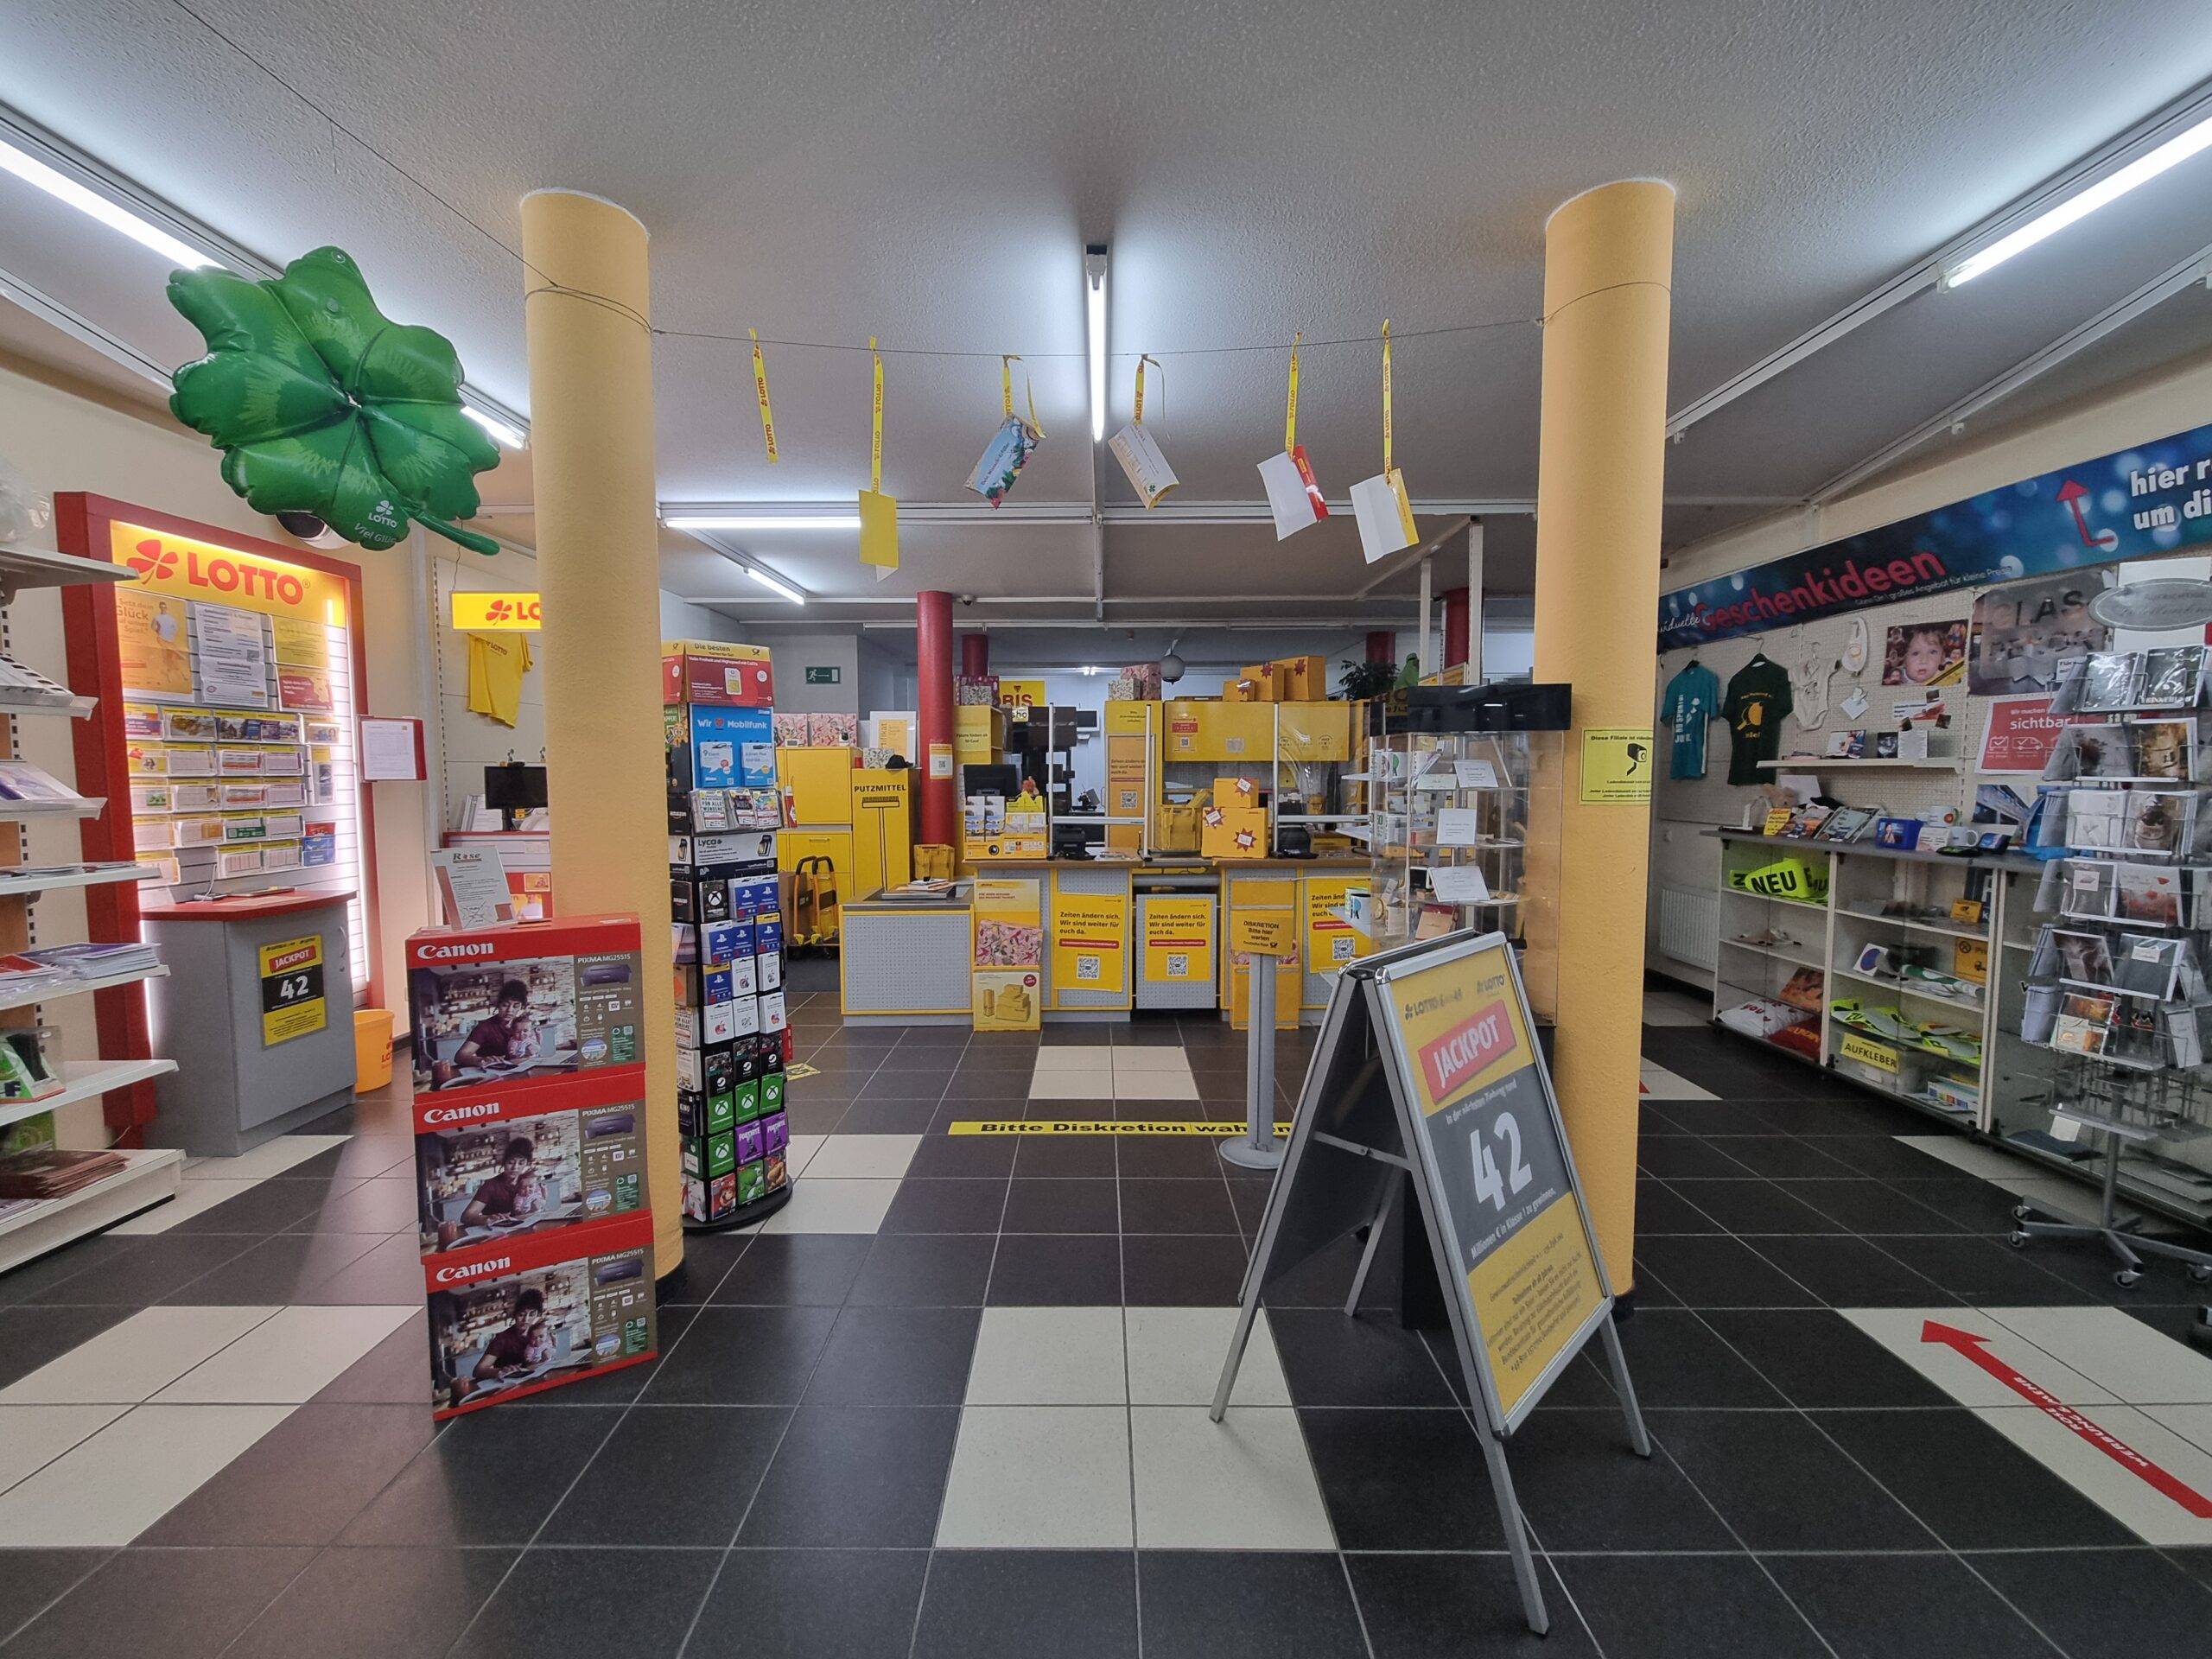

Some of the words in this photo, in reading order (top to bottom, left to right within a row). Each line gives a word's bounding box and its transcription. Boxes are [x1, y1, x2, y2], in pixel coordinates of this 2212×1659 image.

[758, 377, 766, 398] LOTTO
[765, 423, 774, 446] LOTTO
[2131, 465, 2190, 497] hier
[368, 512, 397, 528] LOTTO
[2133, 505, 2175, 530] um
[354, 523, 374, 540] Viel
[187, 551, 303, 606] LOTTO
[1915, 580, 1948, 594] Angebot
[1949, 575, 1961, 586] für
[1962, 571, 1986, 582] kleine
[1696, 550, 1947, 632] Geschenkideen
[116, 606, 149, 621] Glück
[707, 644, 731, 652] besten
[696, 719, 712, 728] Wir
[727, 720, 767, 729] Mobilfunk
[2010, 716, 2072, 730] sichtbar
[854, 784, 906, 793] PUTZMITTEL
[697, 838, 717, 849] Lyca
[1751, 870, 1797, 895] NEU
[1243, 920, 1280, 929] DISKRETION
[275, 949, 310, 969] JACKPOT
[416, 942, 494, 960] Canon
[577, 956, 602, 964] PIXMA
[279, 975, 310, 1000] 42
[1433, 1014, 1500, 1089] JACKPOT
[1844, 1042, 1897, 1067] AUFKLEBER
[423, 1102, 500, 1124] Canon
[582, 1108, 607, 1117] PIXMA
[981, 1123, 1044, 1132] Bitte
[1053, 1123, 1186, 1132] Diskretion
[1195, 1124, 1291, 1133] wahn
[1470, 1111, 1533, 1212] 42
[1471, 1233, 1497, 1260] Millionen
[435, 1256, 512, 1282] Canon
[591, 1255, 616, 1266] PIXMA
[2013, 1376, 2061, 1405] MEHR
[2068, 1414, 2149, 1467] WERBUNG
